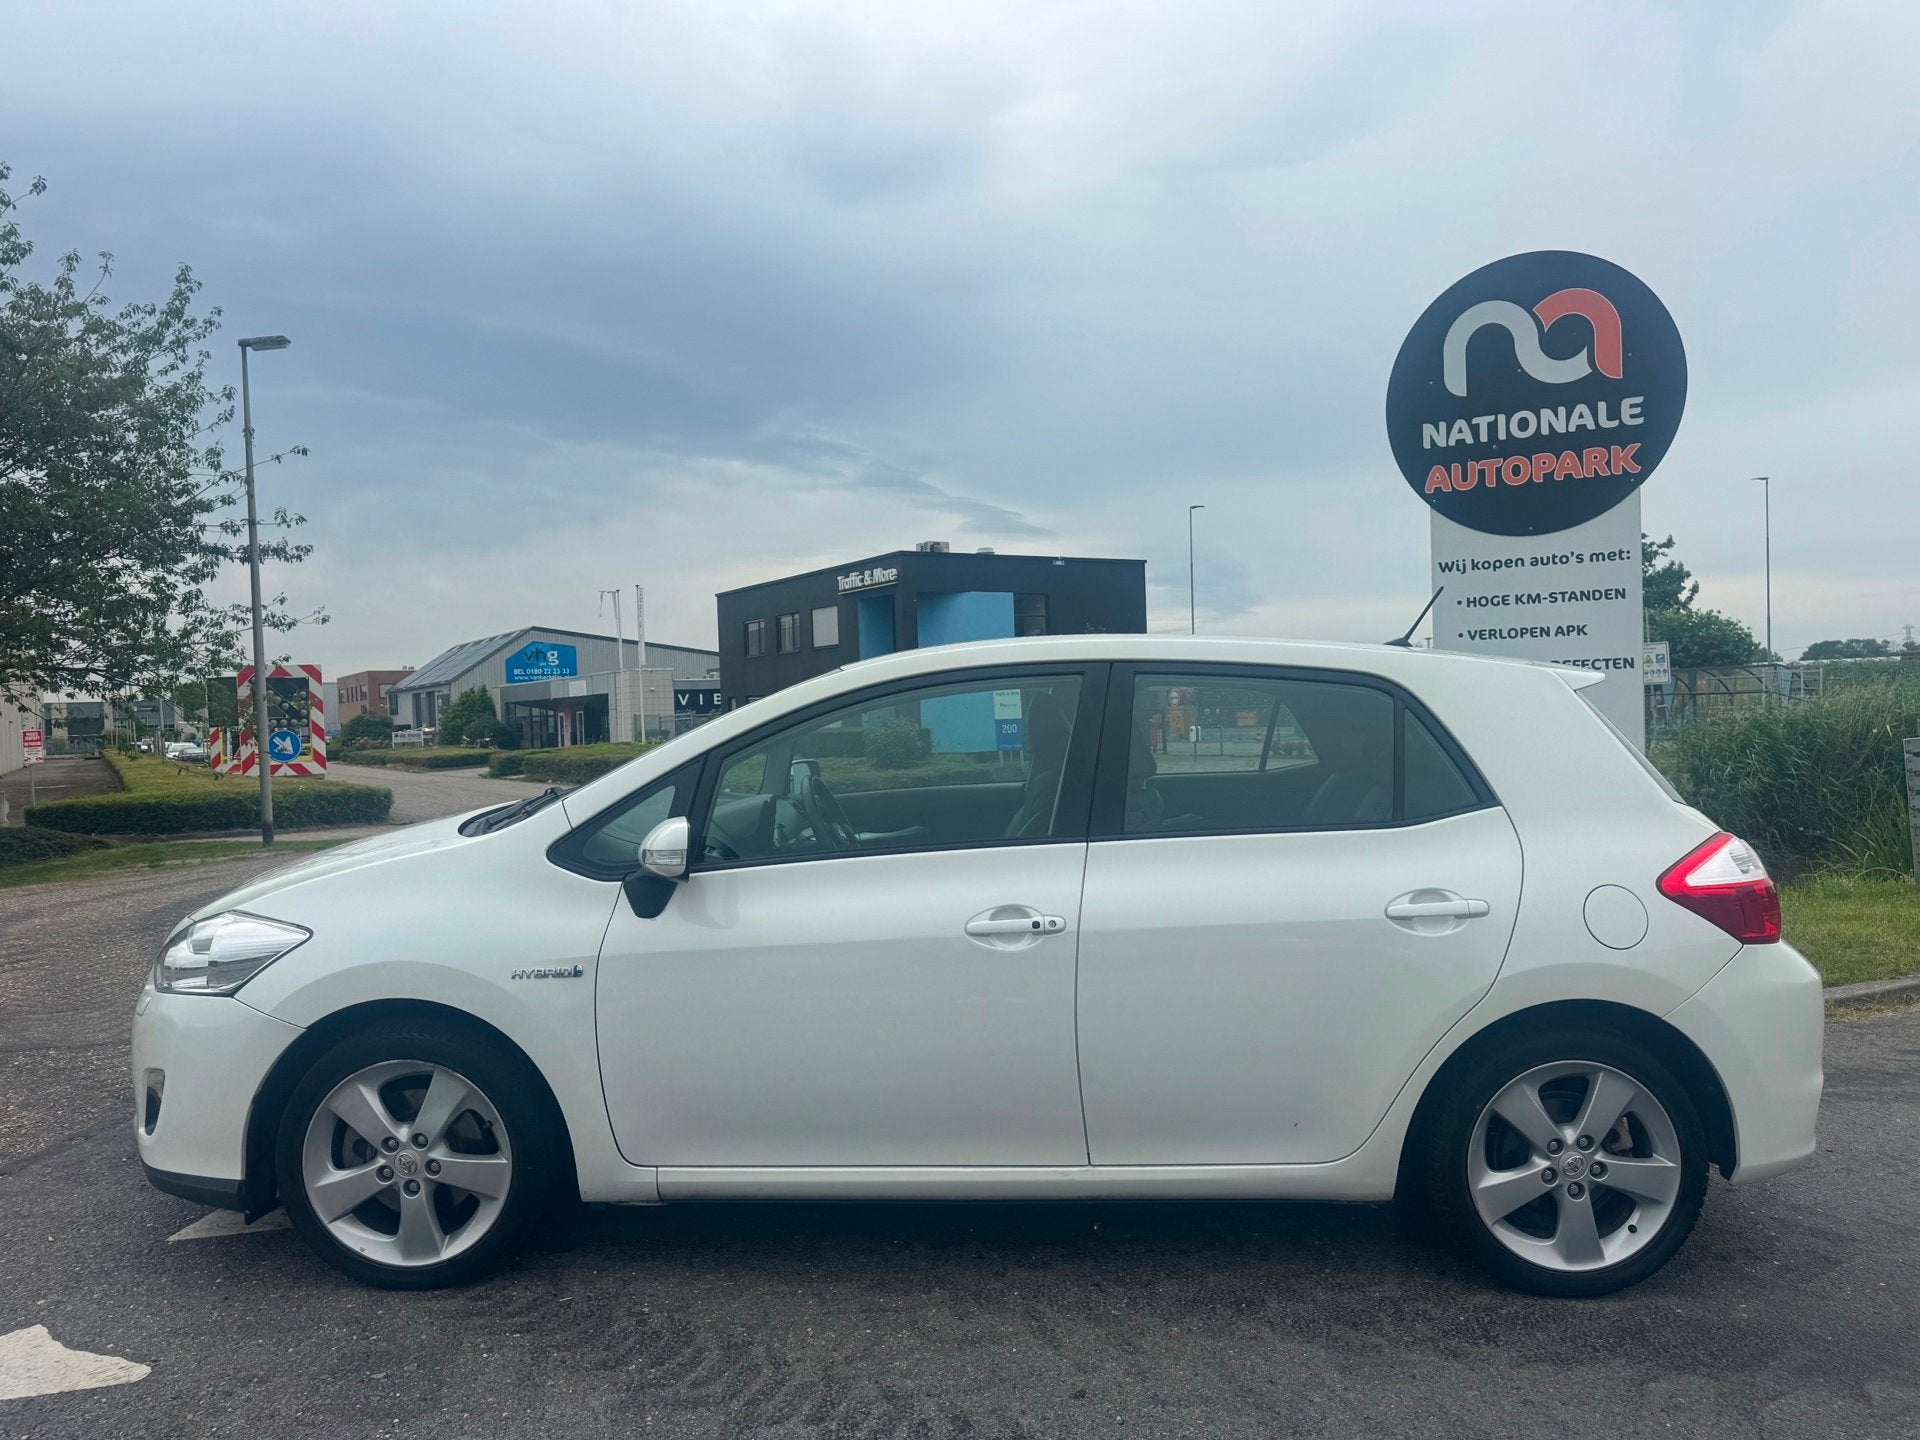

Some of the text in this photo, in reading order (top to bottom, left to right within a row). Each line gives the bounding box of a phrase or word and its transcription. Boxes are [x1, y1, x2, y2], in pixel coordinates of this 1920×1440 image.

[1422, 396, 1645, 449] NATIONALE
[1424, 443, 1642, 494] AUTOPARK
[1438, 548, 1631, 575] Wij kopen auto's met:
[837, 567, 898, 591] Traffic & More
[1466, 587, 1627, 608] HOGE KM-STANDEN
[1467, 624, 1588, 641] VERLOPEN APK
[1002, 724, 1017, 734] 200
[511, 967, 572, 979] HYBRID
